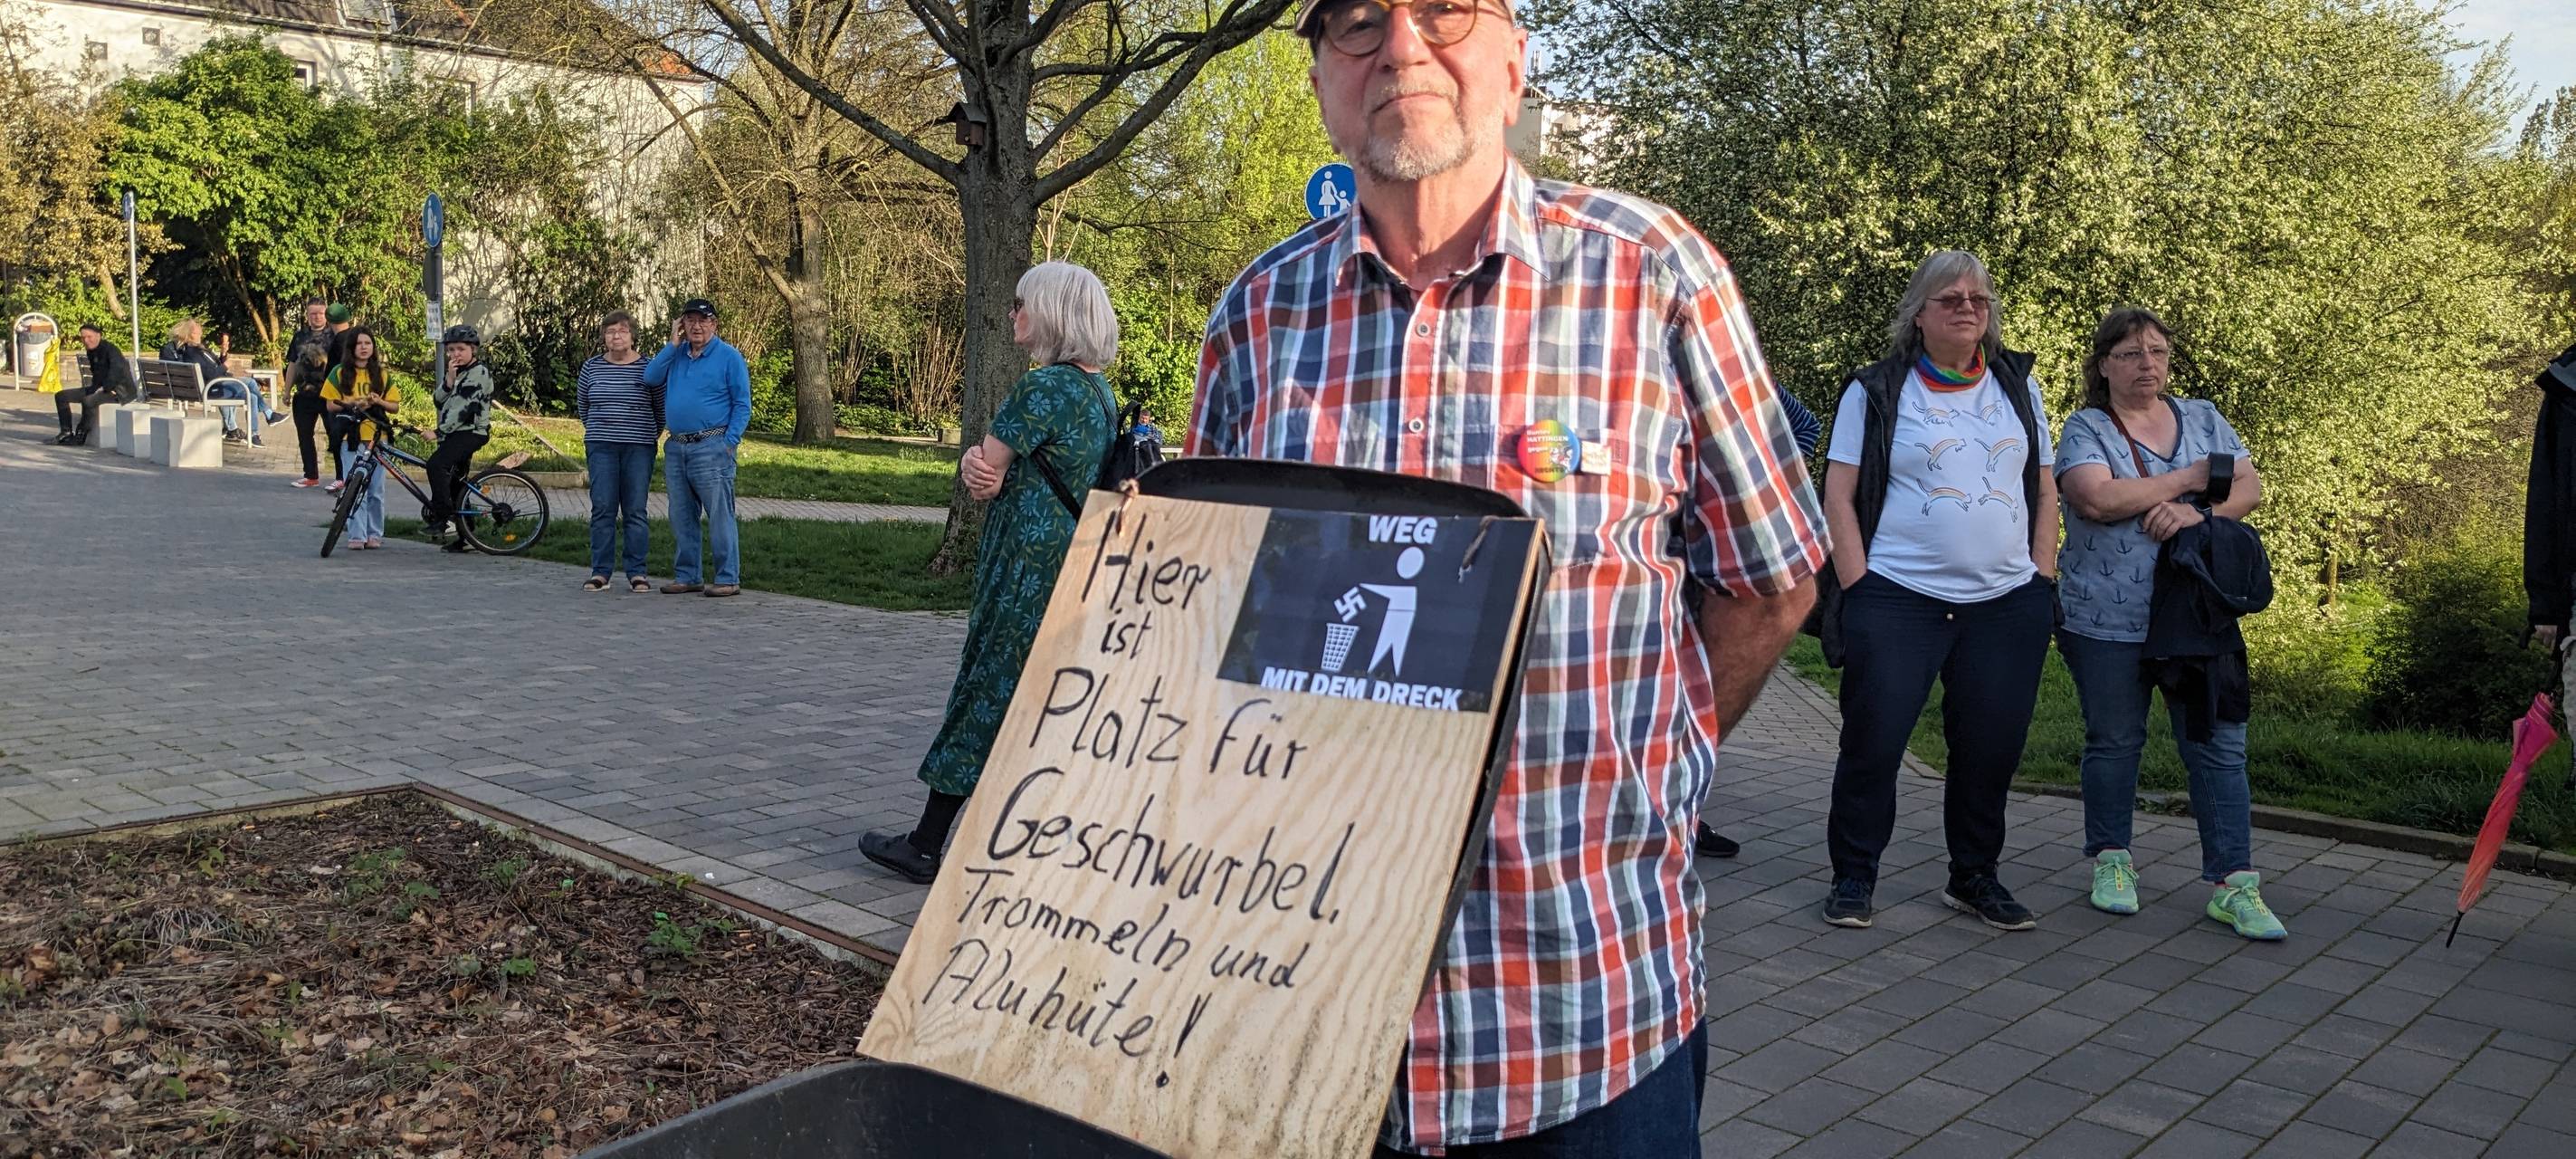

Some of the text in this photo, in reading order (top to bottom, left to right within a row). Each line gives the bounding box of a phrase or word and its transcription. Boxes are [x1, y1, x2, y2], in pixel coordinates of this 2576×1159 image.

[1082, 510, 1212, 610] Hier
[1368, 515, 1438, 544] WEG
[1100, 608, 1153, 660] ist
[1028, 666, 1308, 780] Platz für
[1260, 666, 1463, 712] MIT DEM DRECK
[956, 866, 1310, 989] Trommeln und
